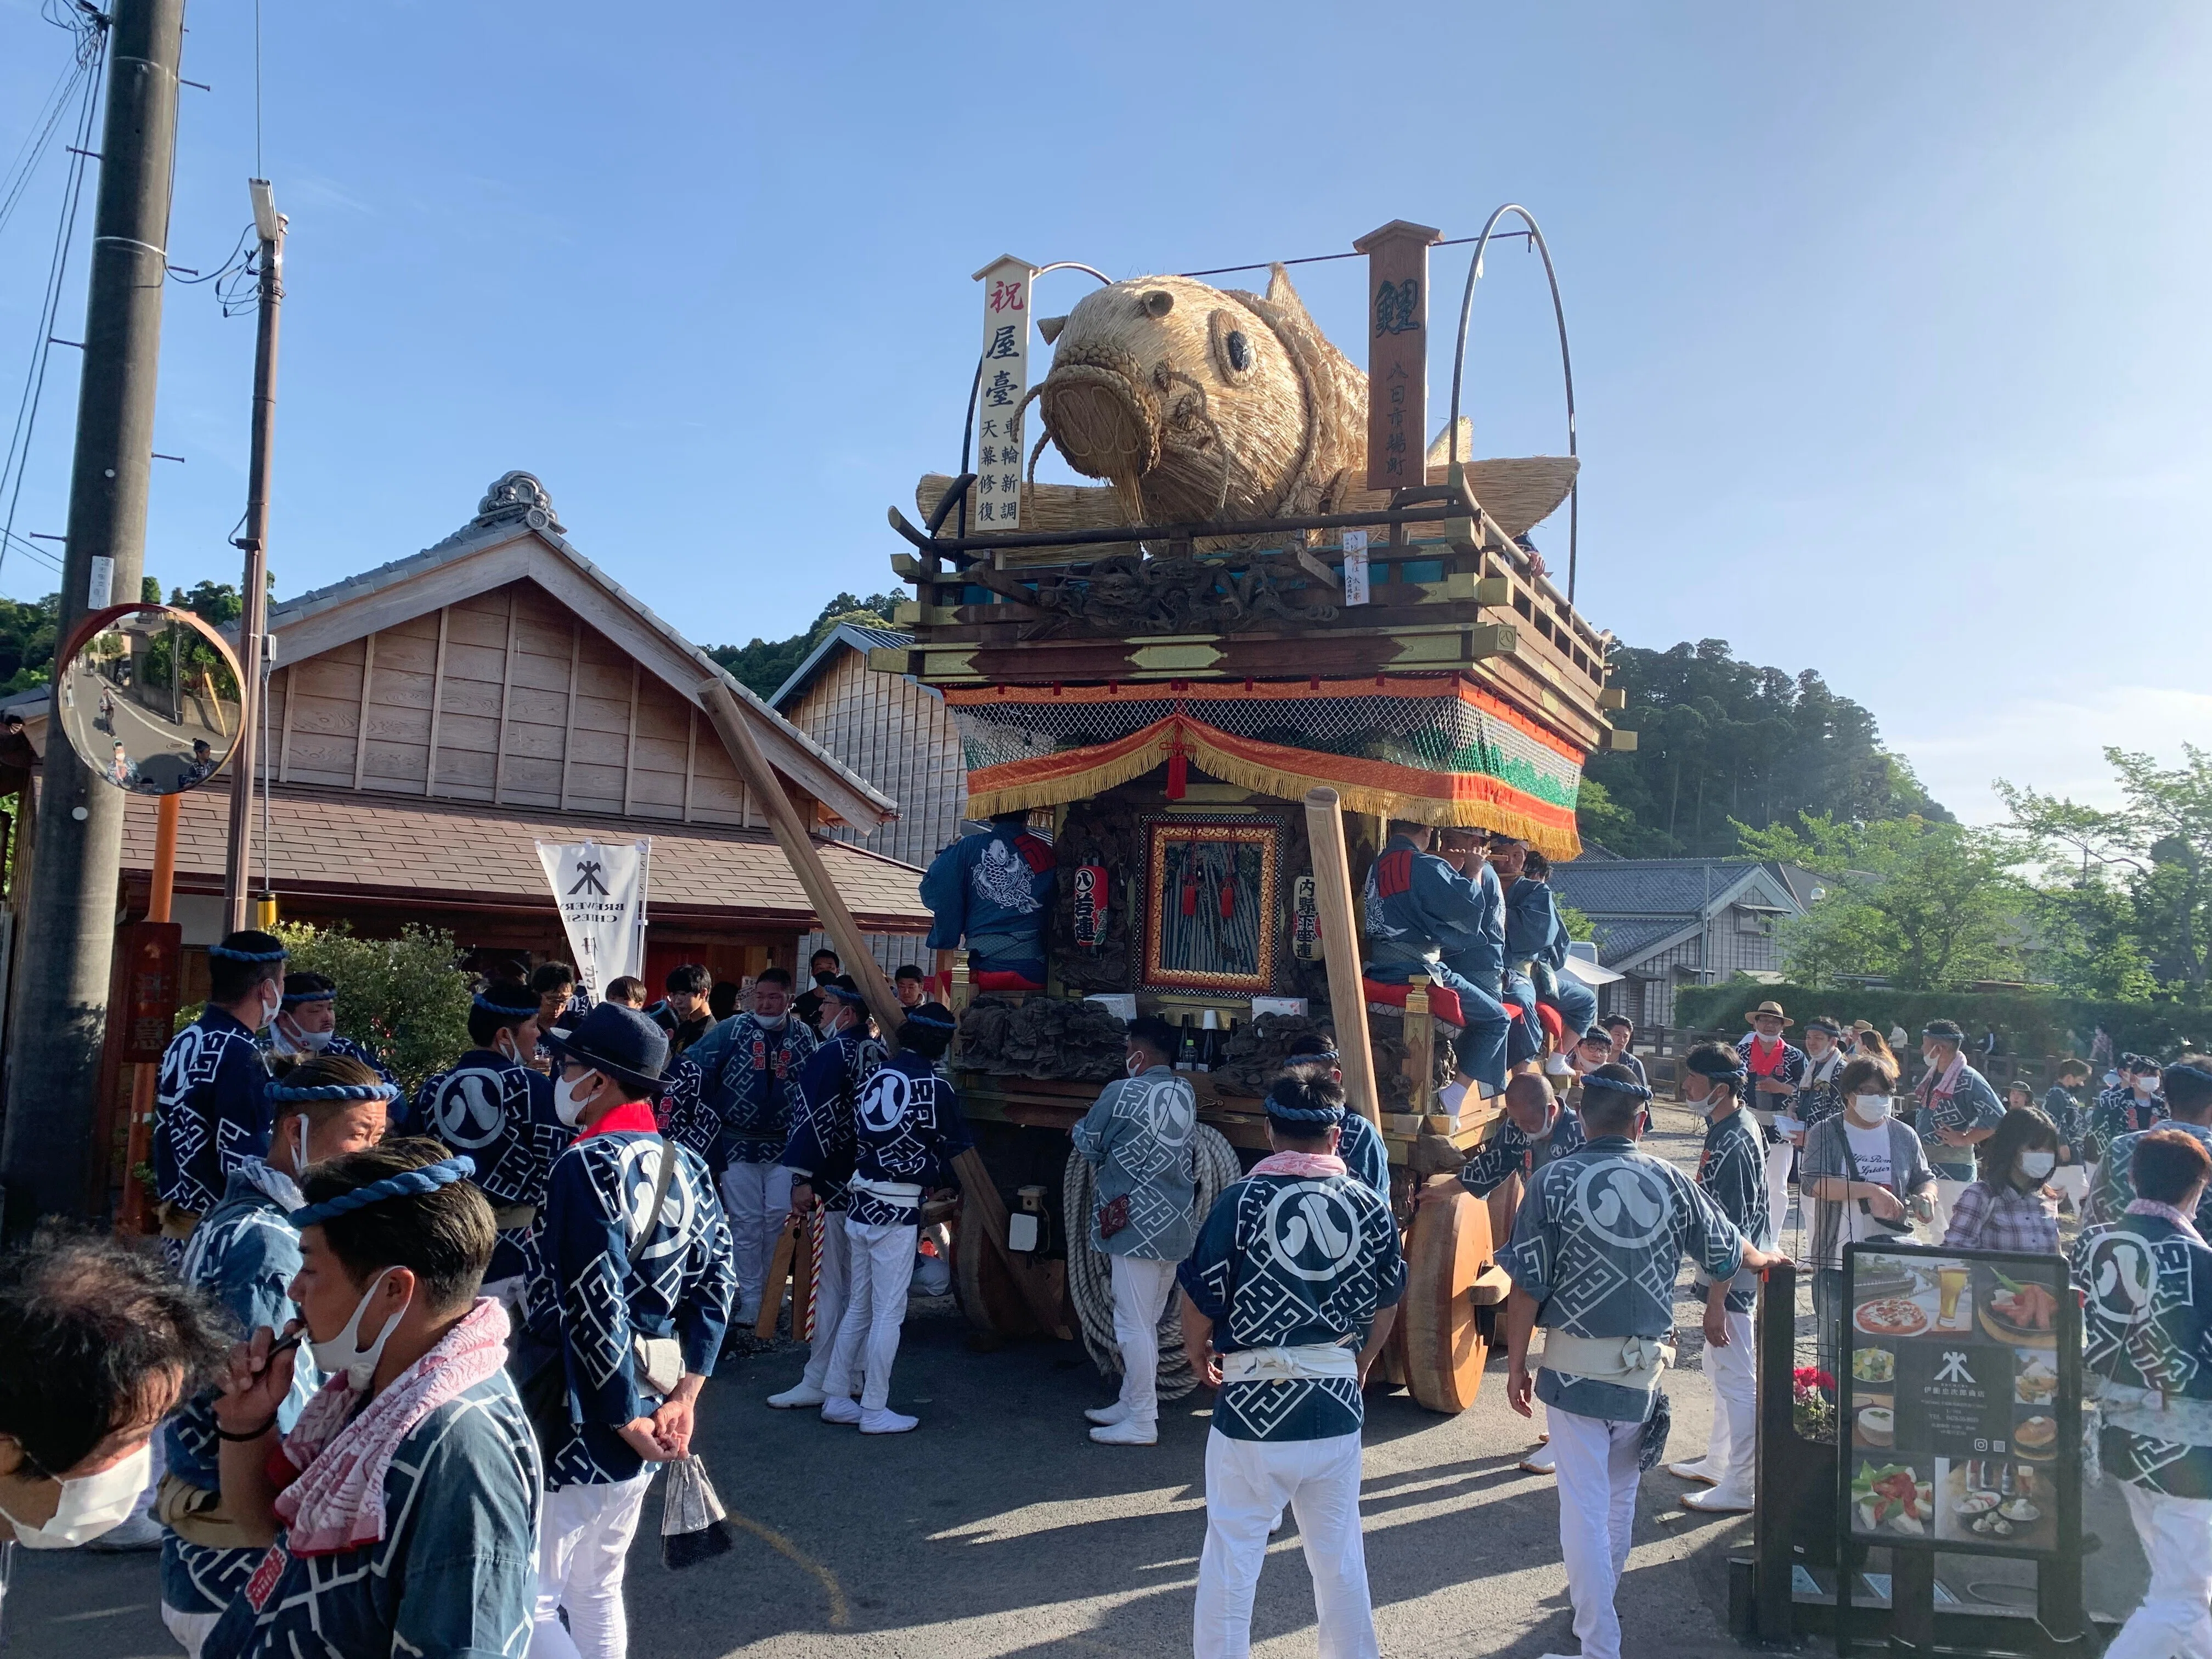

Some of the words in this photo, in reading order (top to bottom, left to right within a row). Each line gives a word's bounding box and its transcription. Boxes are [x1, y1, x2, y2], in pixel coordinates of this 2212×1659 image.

[1374, 279, 1420, 338] 鯉
[1386, 360, 1409, 476] 八日市場町
[977, 419, 998, 522] 天幕修復
[1859, 1165, 1890, 1176] Spider
